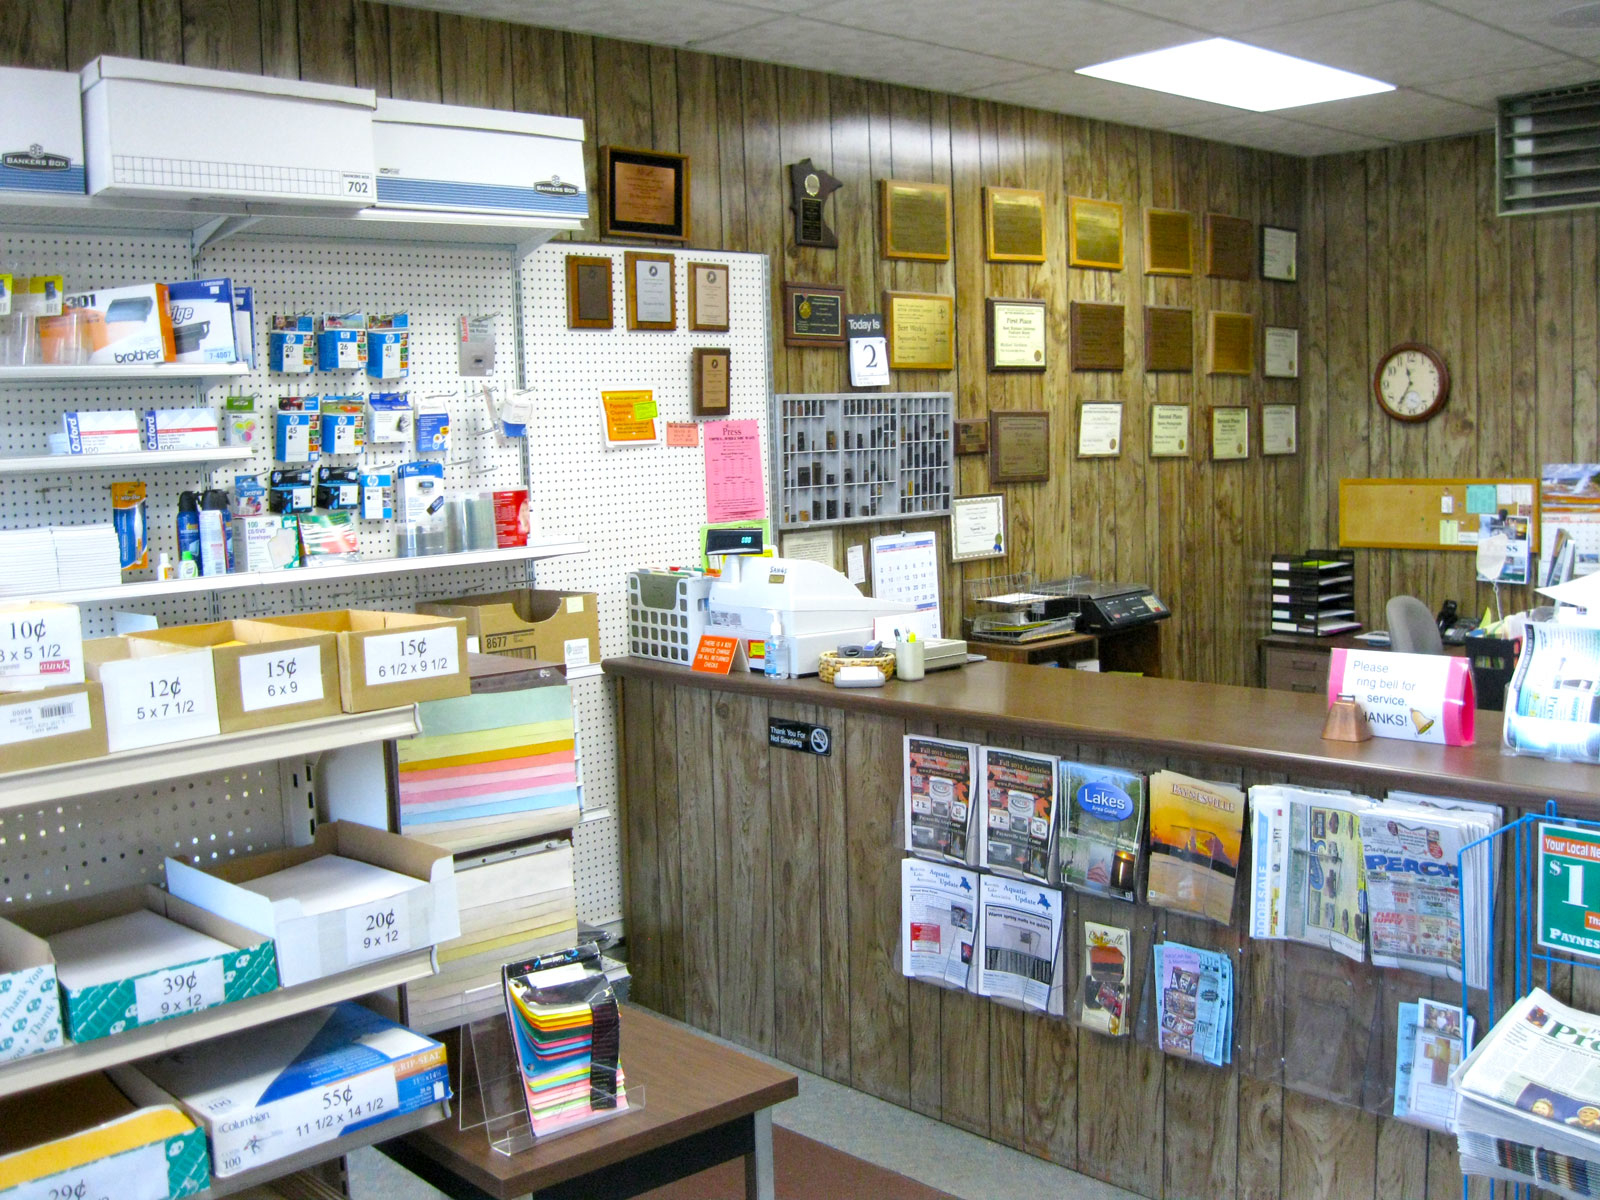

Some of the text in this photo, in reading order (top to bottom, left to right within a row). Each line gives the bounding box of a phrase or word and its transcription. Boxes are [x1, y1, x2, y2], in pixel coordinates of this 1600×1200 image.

[7, 156, 66, 167] BANKERS BOX
[348, 181, 368, 193] 702
[848, 319, 880, 332] Today Is
[114, 349, 161, 363] brother
[863, 344, 877, 367] 2
[1407, 352, 1416, 363] 12
[1388, 366, 1396, 376] 10
[68, 418, 80, 452] Oxford
[147, 416, 158, 451] Oxford
[11, 618, 46, 642] 10¢
[400, 638, 427, 656] 15¢
[486, 636, 507, 649] 8677
[11, 644, 61, 661] x 5 1/2
[268, 658, 297, 678] 15¢
[379, 658, 447, 677] 6 1/2 x 9 1/2
[1353, 660, 1389, 673] Please
[149, 677, 181, 698] 12¢
[268, 681, 298, 696] 6 x 9
[1357, 678, 1416, 691] ring bell for
[1367, 694, 1407, 706] service.
[137, 701, 194, 720] 5 x 7 1/2
[770, 726, 786, 734] Thank
[780, 736, 802, 748] Smoking
[944, 751, 967, 760] Activities
[1024, 765, 1050, 774] Activities
[1084, 788, 1125, 810] Lakes
[1172, 784, 1235, 812] PAYNESVILLE
[1104, 807, 1117, 815] Guide
[1364, 844, 1403, 855] Dairyland
[1545, 838, 1565, 851] Your
[1566, 841, 1588, 856] Local
[930, 870, 950, 879] Aquatic
[1364, 855, 1458, 878] PEACH
[940, 879, 958, 888] Update
[1004, 885, 1026, 895] Aquatic
[1015, 895, 1036, 905] Update
[1256, 866, 1267, 937] DOOR SALE
[366, 909, 395, 931] 20¢
[1036, 922, 1050, 930] quickly
[364, 930, 398, 949] 9 x 12
[163, 970, 197, 995] 39¢
[2, 968, 43, 1019] Thank You
[161, 995, 202, 1014] 9 x 12
[29, 1005, 55, 1036] Thank
[322, 1084, 353, 1111] 55¢
[220, 1111, 270, 1133] Columbian
[296, 1124, 309, 1137] 11
[315, 1116, 333, 1130] 1/2
[348, 1105, 361, 1118] 14
[367, 1098, 383, 1112] 1/2
[224, 1156, 241, 1169] 100
